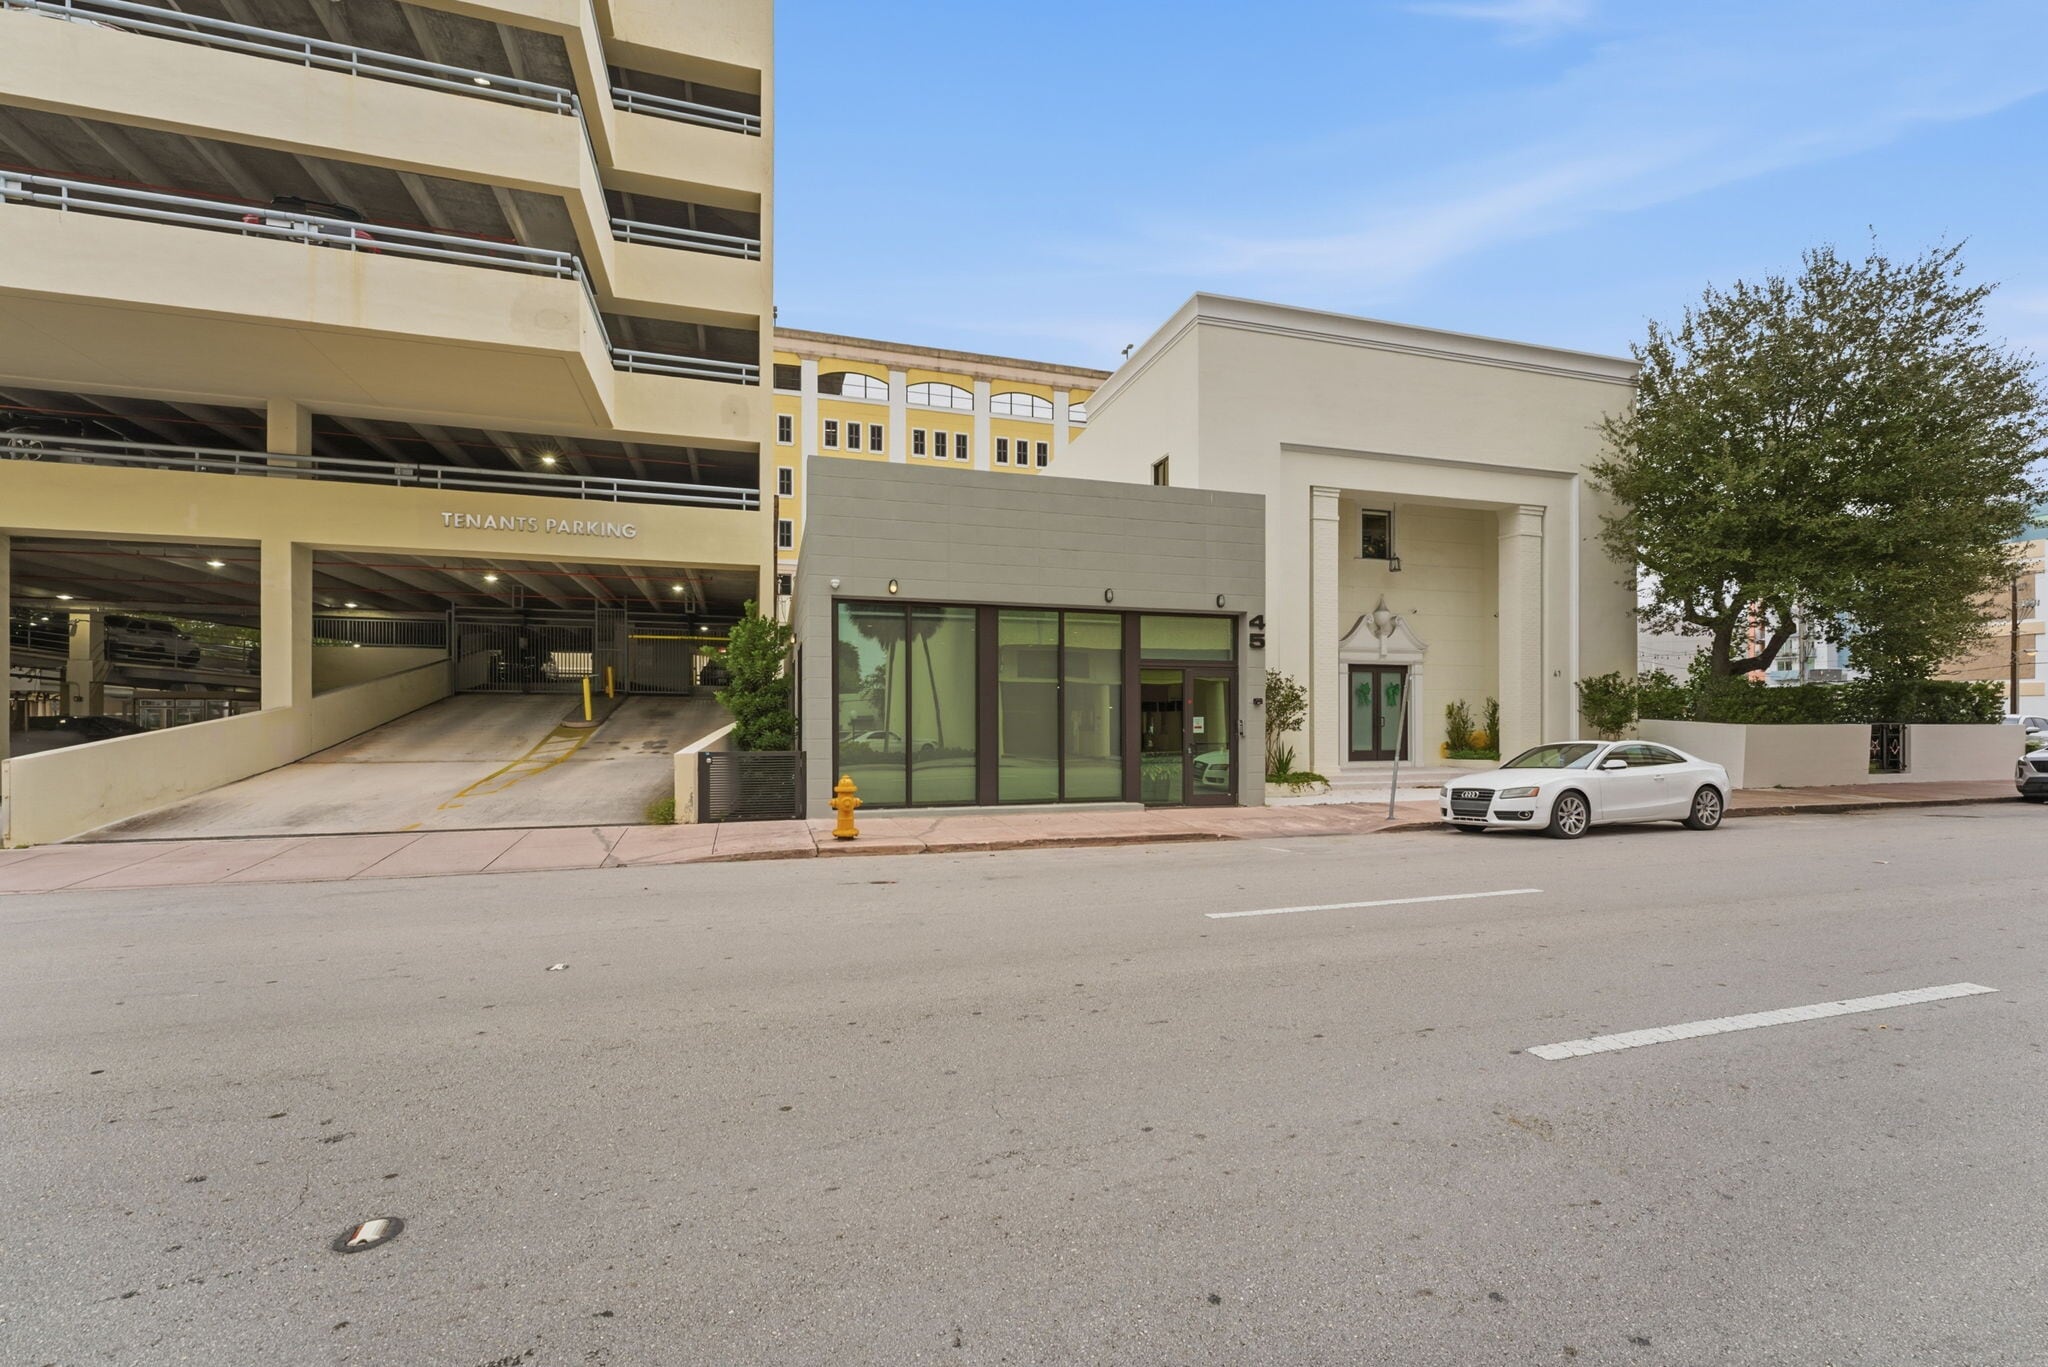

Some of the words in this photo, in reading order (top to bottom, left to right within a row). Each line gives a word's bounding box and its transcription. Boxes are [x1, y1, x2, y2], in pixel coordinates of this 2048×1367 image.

[441, 512, 537, 532] TENANTS
[546, 519, 637, 538] PARKING
[1249, 615, 1265, 649] 45
